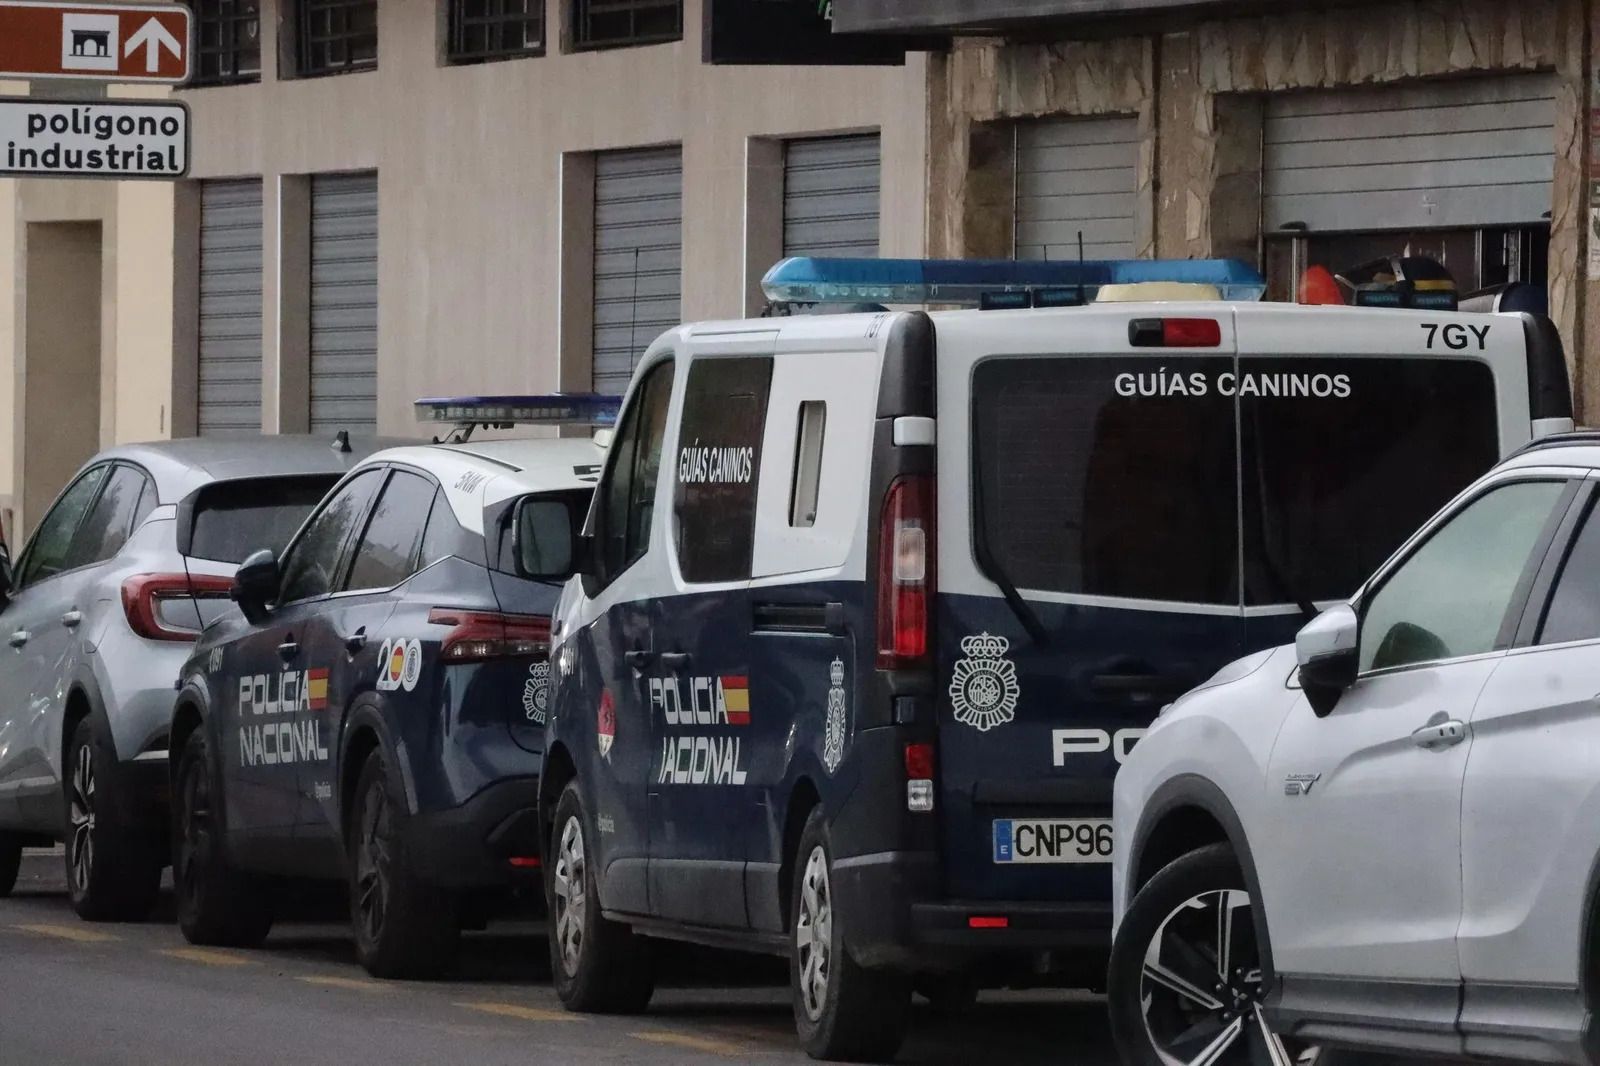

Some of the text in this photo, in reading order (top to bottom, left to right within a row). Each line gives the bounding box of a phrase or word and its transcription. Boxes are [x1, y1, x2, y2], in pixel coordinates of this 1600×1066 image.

[28, 108, 179, 140] polígono
[8, 141, 178, 171] industrial
[1420, 323, 1491, 350] 7GY
[1114, 367, 1351, 397] GUÍAS CANINOS
[680, 437, 753, 483] GUÍAS CANINOS
[240, 719, 328, 767] NACIONAL
[1000, 823, 1113, 857] E CNP96
